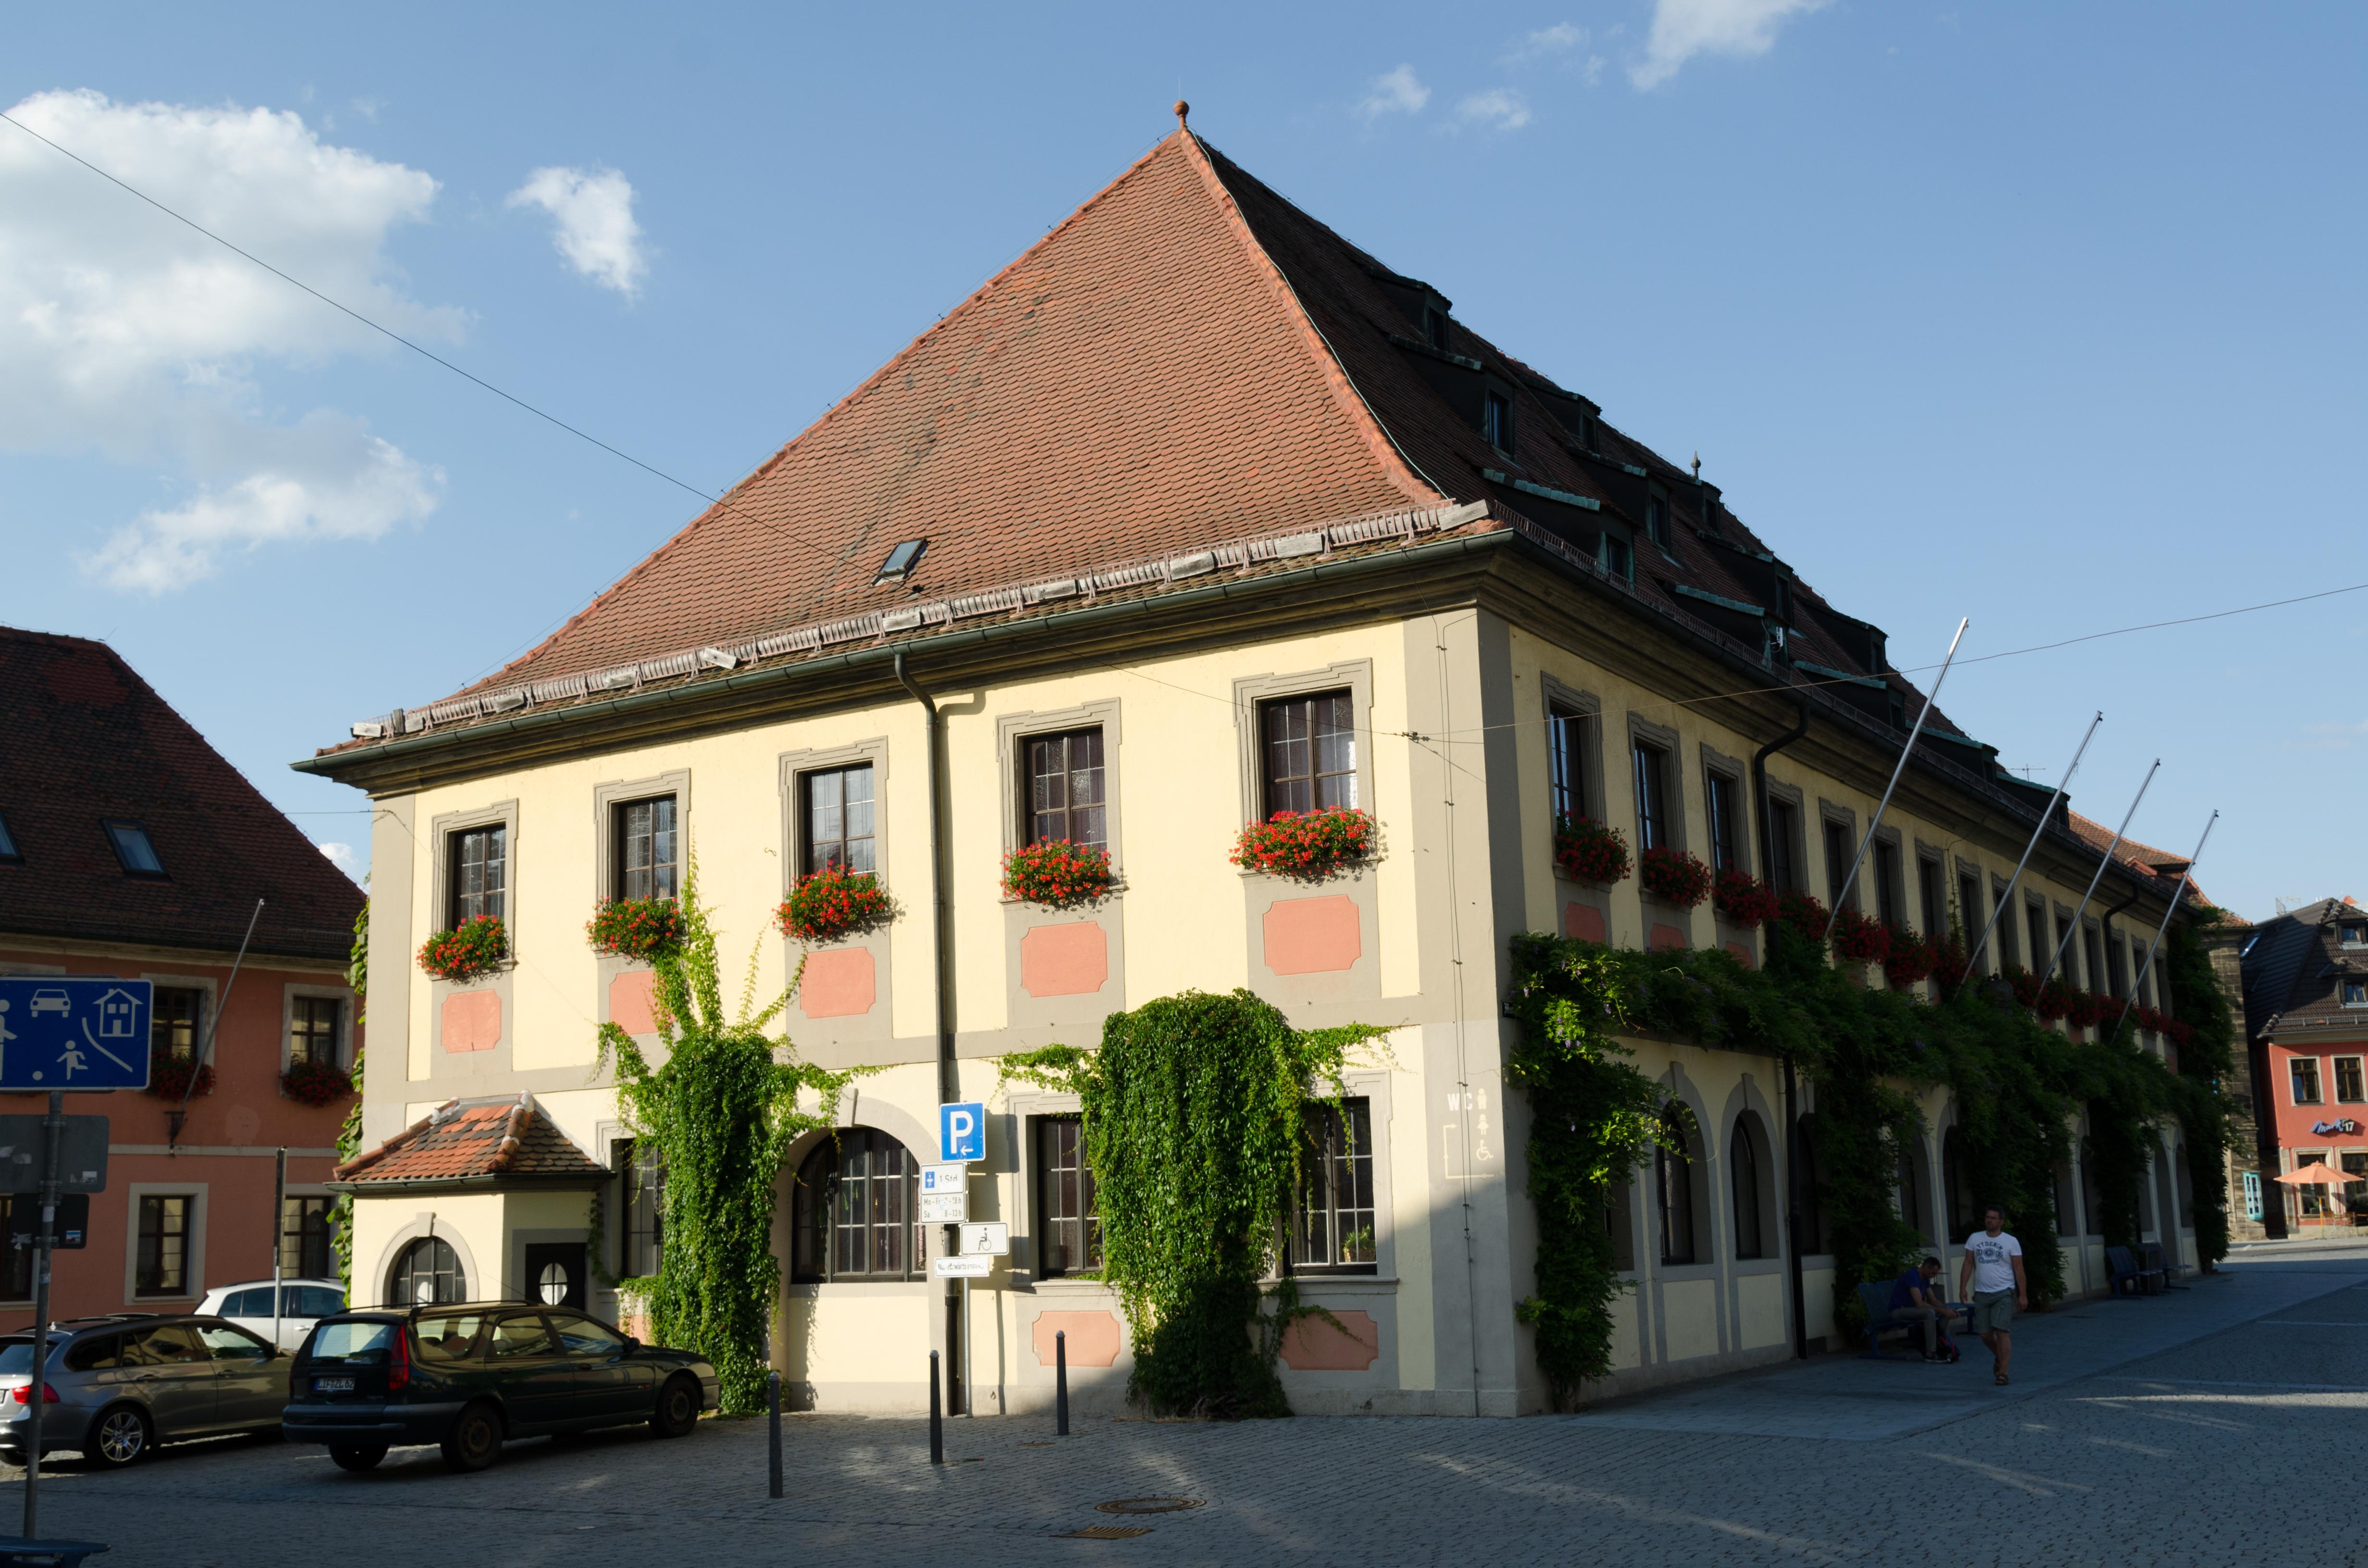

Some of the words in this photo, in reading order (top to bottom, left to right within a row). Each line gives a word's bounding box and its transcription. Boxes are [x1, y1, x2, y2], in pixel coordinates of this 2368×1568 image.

[1447, 1092, 1473, 1111] WC
[950, 1111, 974, 1154] P
[2345, 1122, 2355, 1132] 17
[319, 1378, 331, 1388] LIF
[334, 1378, 344, 1388] ZL
[345, 1378, 354, 1388] 62
